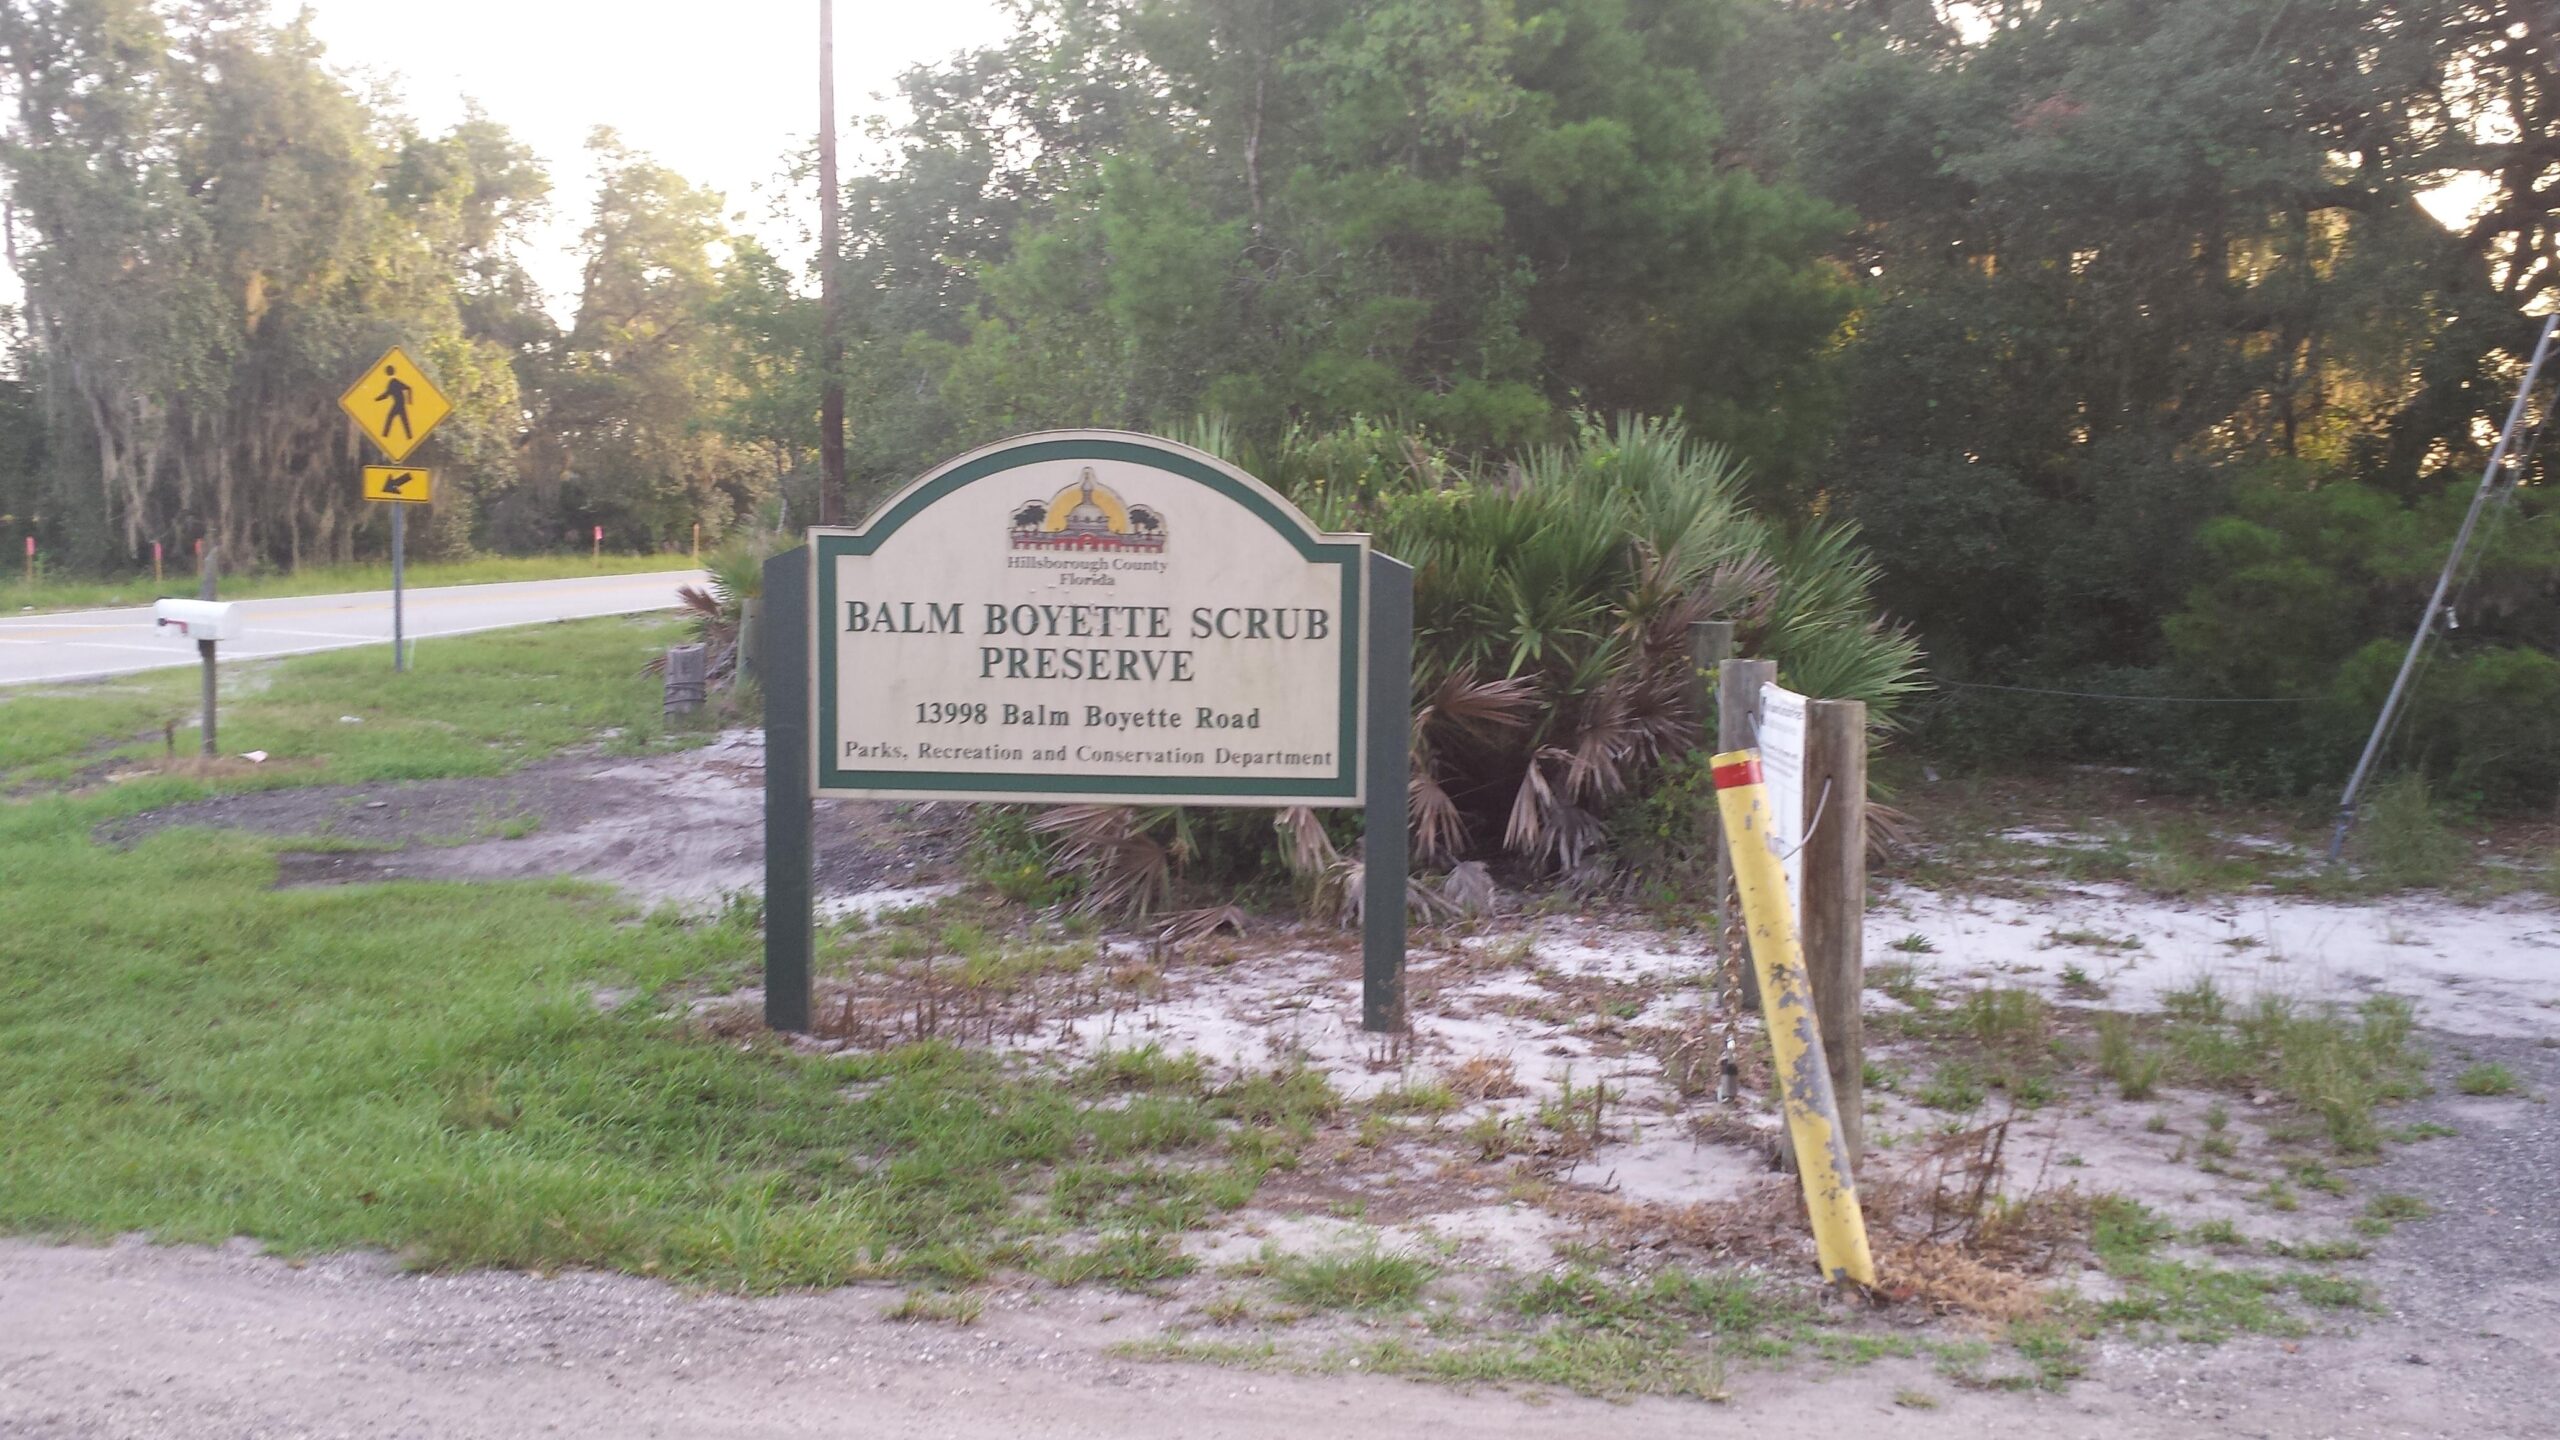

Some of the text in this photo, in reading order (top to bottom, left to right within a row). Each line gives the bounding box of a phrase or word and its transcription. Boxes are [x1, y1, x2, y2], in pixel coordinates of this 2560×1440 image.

[1008, 556, 1167, 573] Hillsborough County
[1060, 573, 1115, 586] Florida
[845, 601, 1328, 640] BALM BOYETTE SCRUB
[980, 647, 1194, 681] PRESERVE
[916, 702, 1260, 731] 13998 Balm Boyette Road
[845, 741, 1332, 767] Parks, Recreation and Conservation Department
